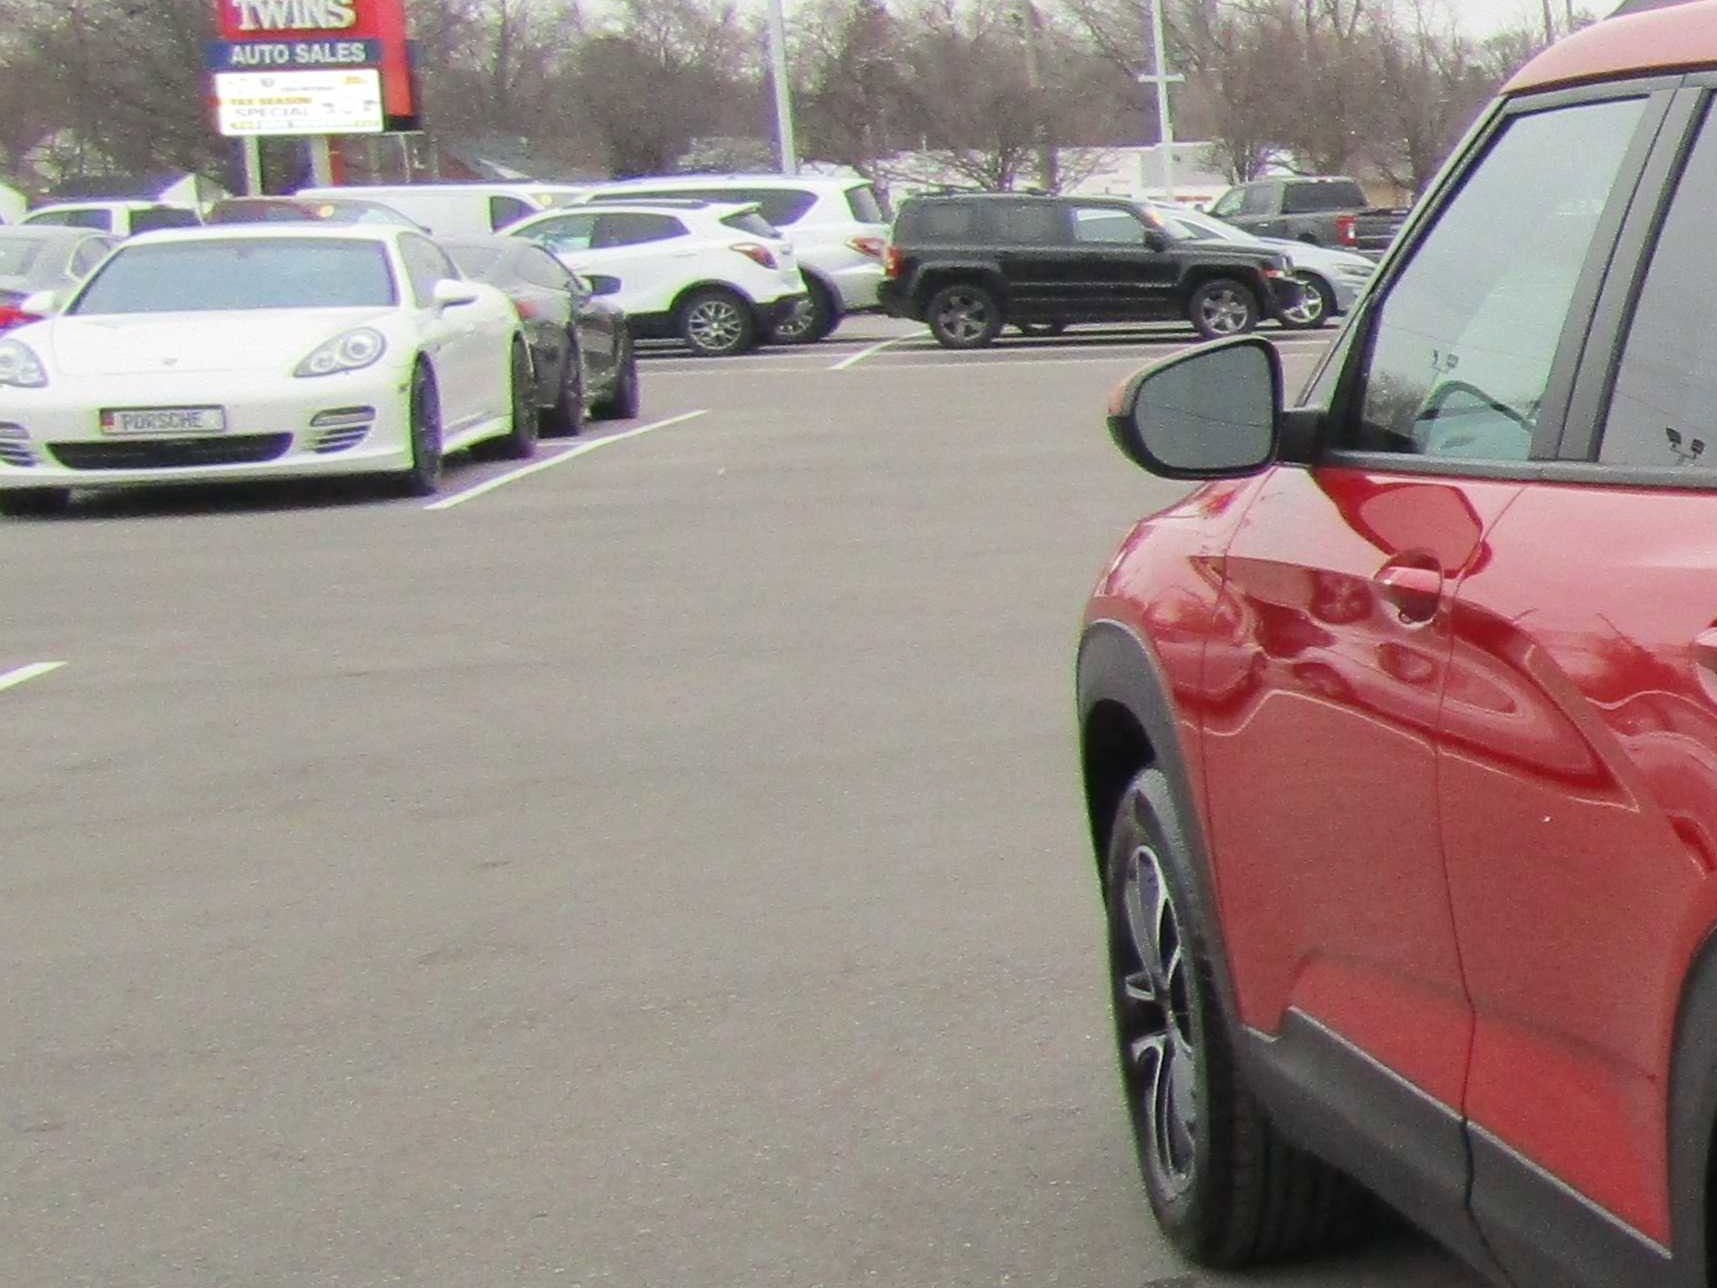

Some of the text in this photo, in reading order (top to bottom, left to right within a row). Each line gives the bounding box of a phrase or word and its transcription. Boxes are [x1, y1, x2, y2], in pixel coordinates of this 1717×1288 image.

[231, 42, 366, 64] AUTO SALES
[121, 411, 203, 430] PORSCHE
